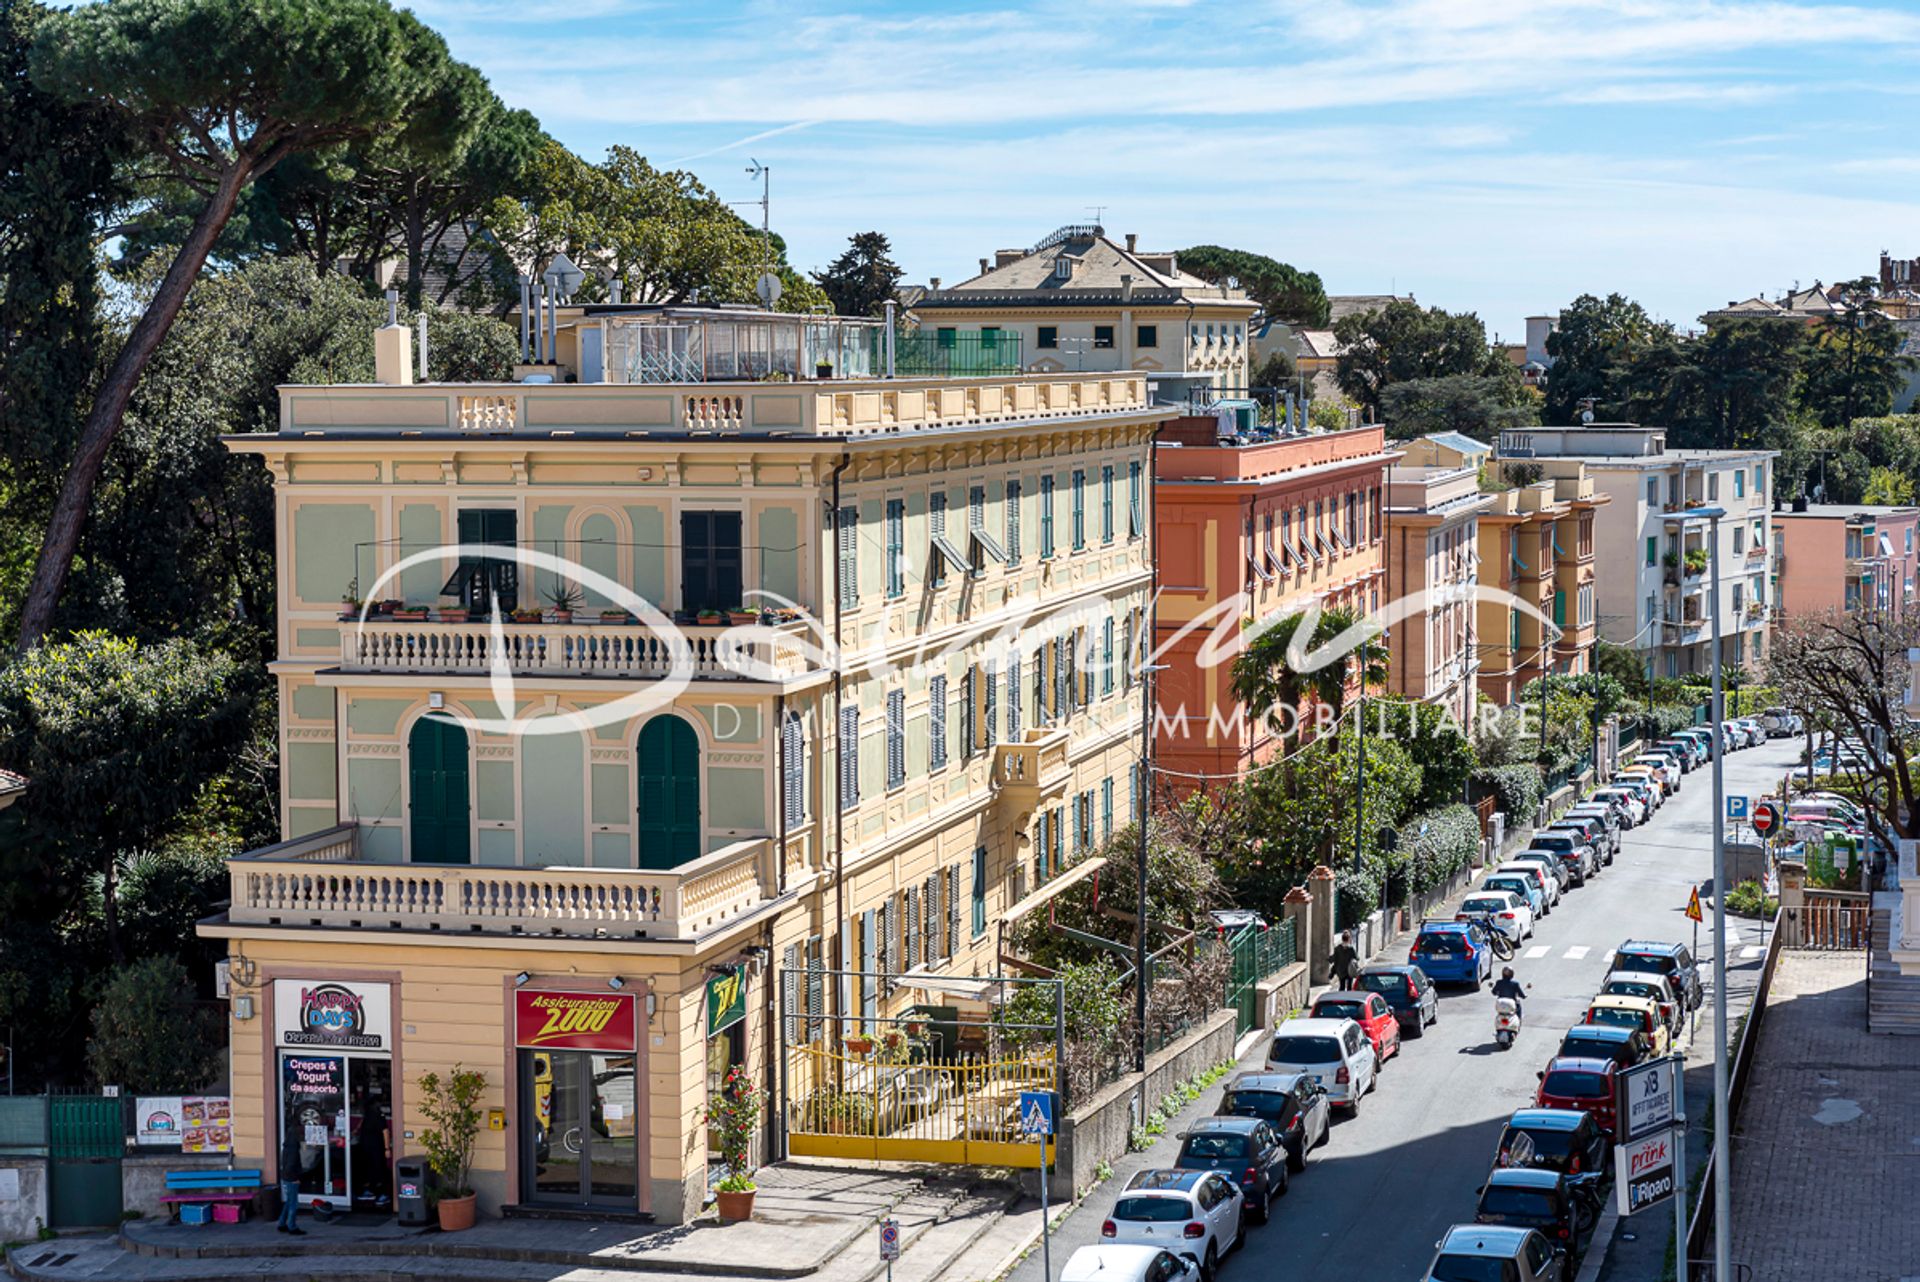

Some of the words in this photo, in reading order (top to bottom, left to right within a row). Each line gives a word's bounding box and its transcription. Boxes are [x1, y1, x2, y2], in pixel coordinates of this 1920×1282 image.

[1731, 798, 1744, 815] P
[530, 996, 623, 1011] Assicurazioni
[310, 1010, 353, 1027] DAYS
[537, 1007, 614, 1036] 2000
[290, 1060, 326, 1071] Crepes
[328, 1060, 337, 1071] &
[296, 1071, 331, 1083] Yogurt
[290, 1083, 302, 1093] da
[303, 1084, 338, 1094] asporto
